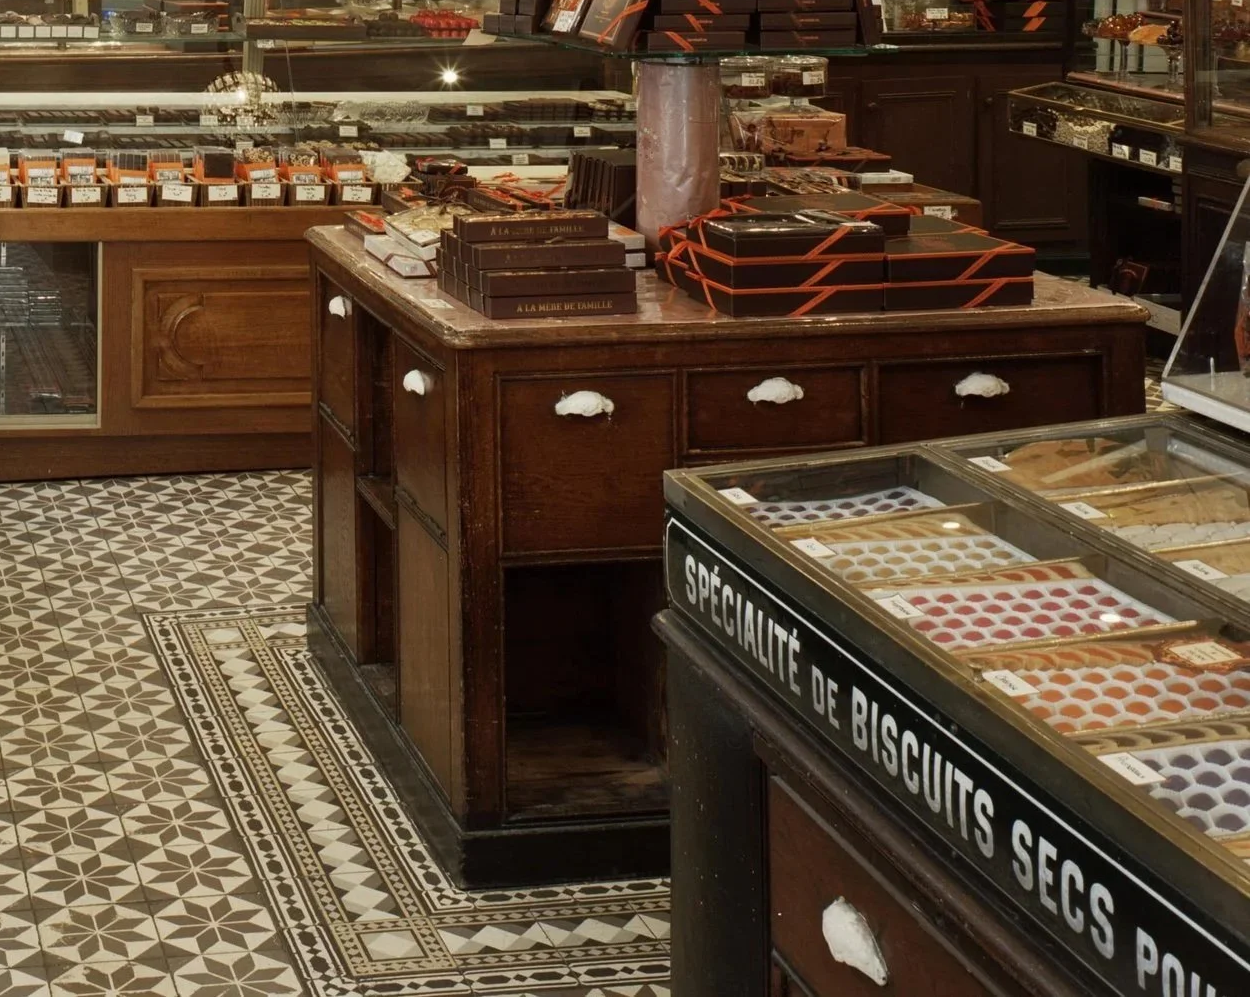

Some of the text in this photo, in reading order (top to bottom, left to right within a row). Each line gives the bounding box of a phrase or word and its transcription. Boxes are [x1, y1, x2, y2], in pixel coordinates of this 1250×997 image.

[525, 303, 537, 313] LA
[564, 301, 576, 311] DE
[577, 299, 613, 310] FAMILLE
[683, 553, 802, 697] SPÉCIALITÉ
[811, 664, 840, 730] DE
[851, 685, 995, 859] BISCUITS
[1011, 818, 1115, 961] SECS
